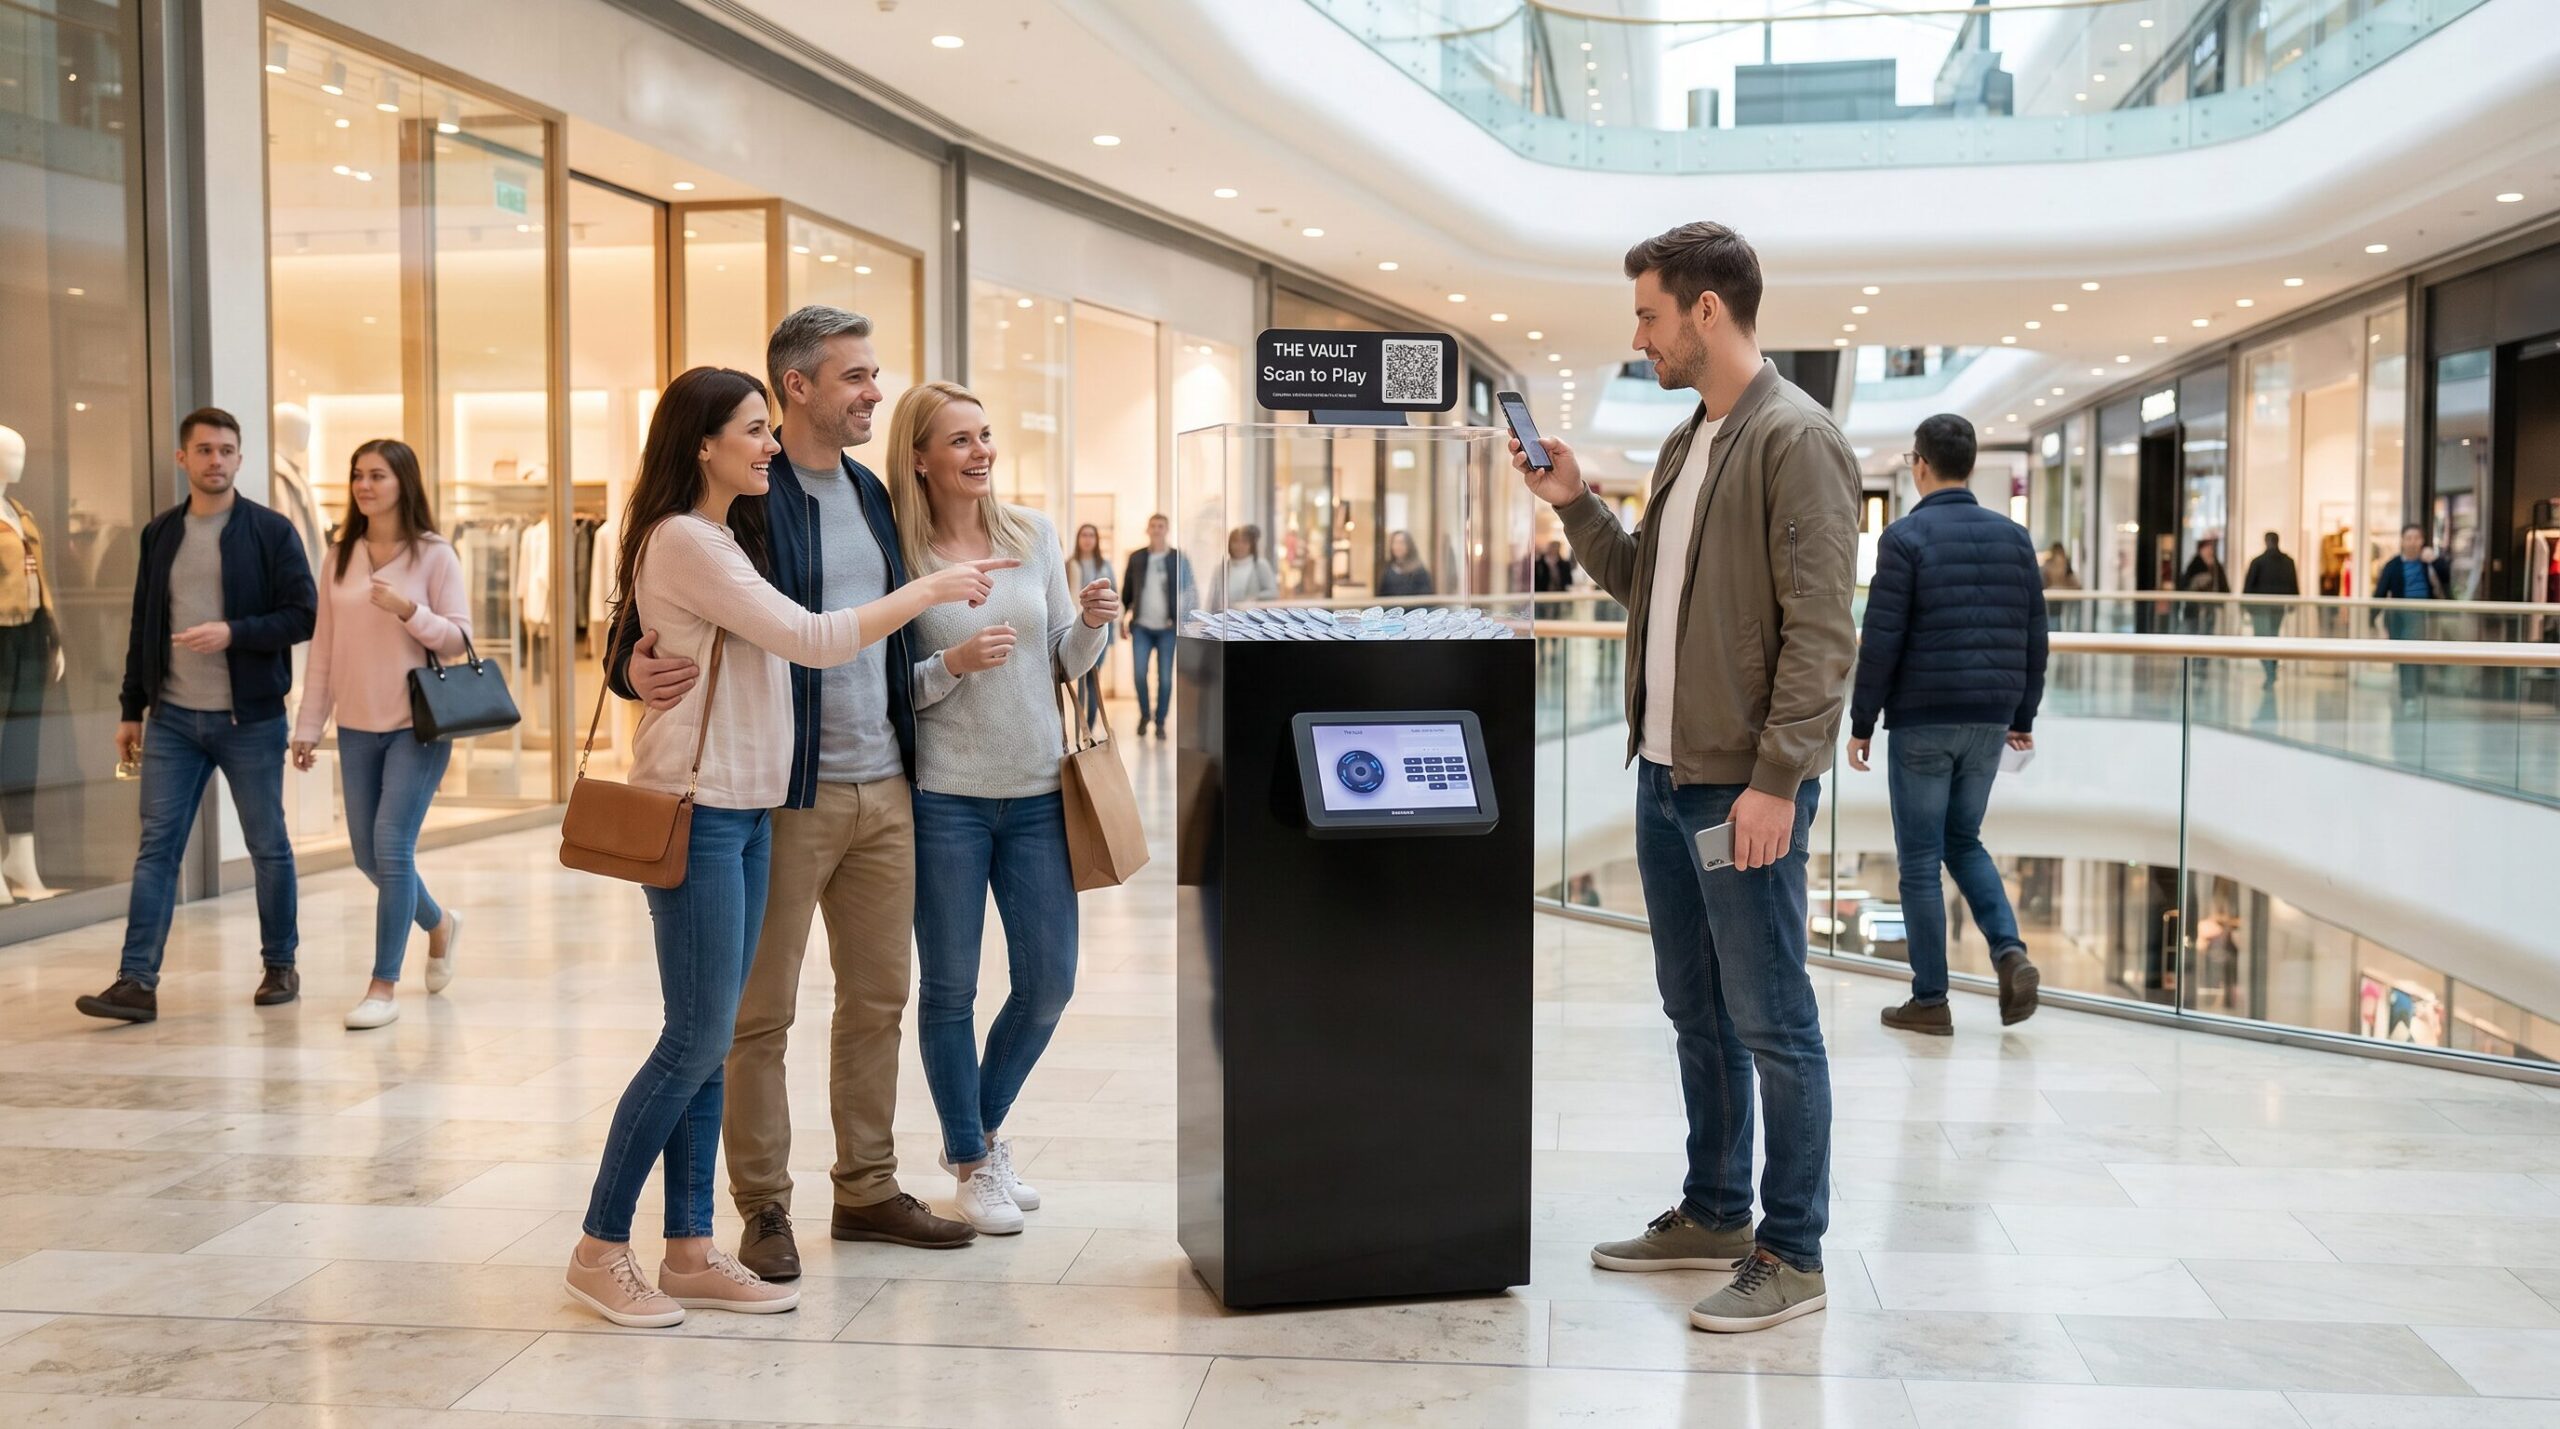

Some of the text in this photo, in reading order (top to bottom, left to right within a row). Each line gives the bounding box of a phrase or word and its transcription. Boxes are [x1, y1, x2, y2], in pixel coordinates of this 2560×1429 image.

[1273, 343, 1357, 358] THE VAULT
[1263, 366, 1367, 386] Scan to Play
